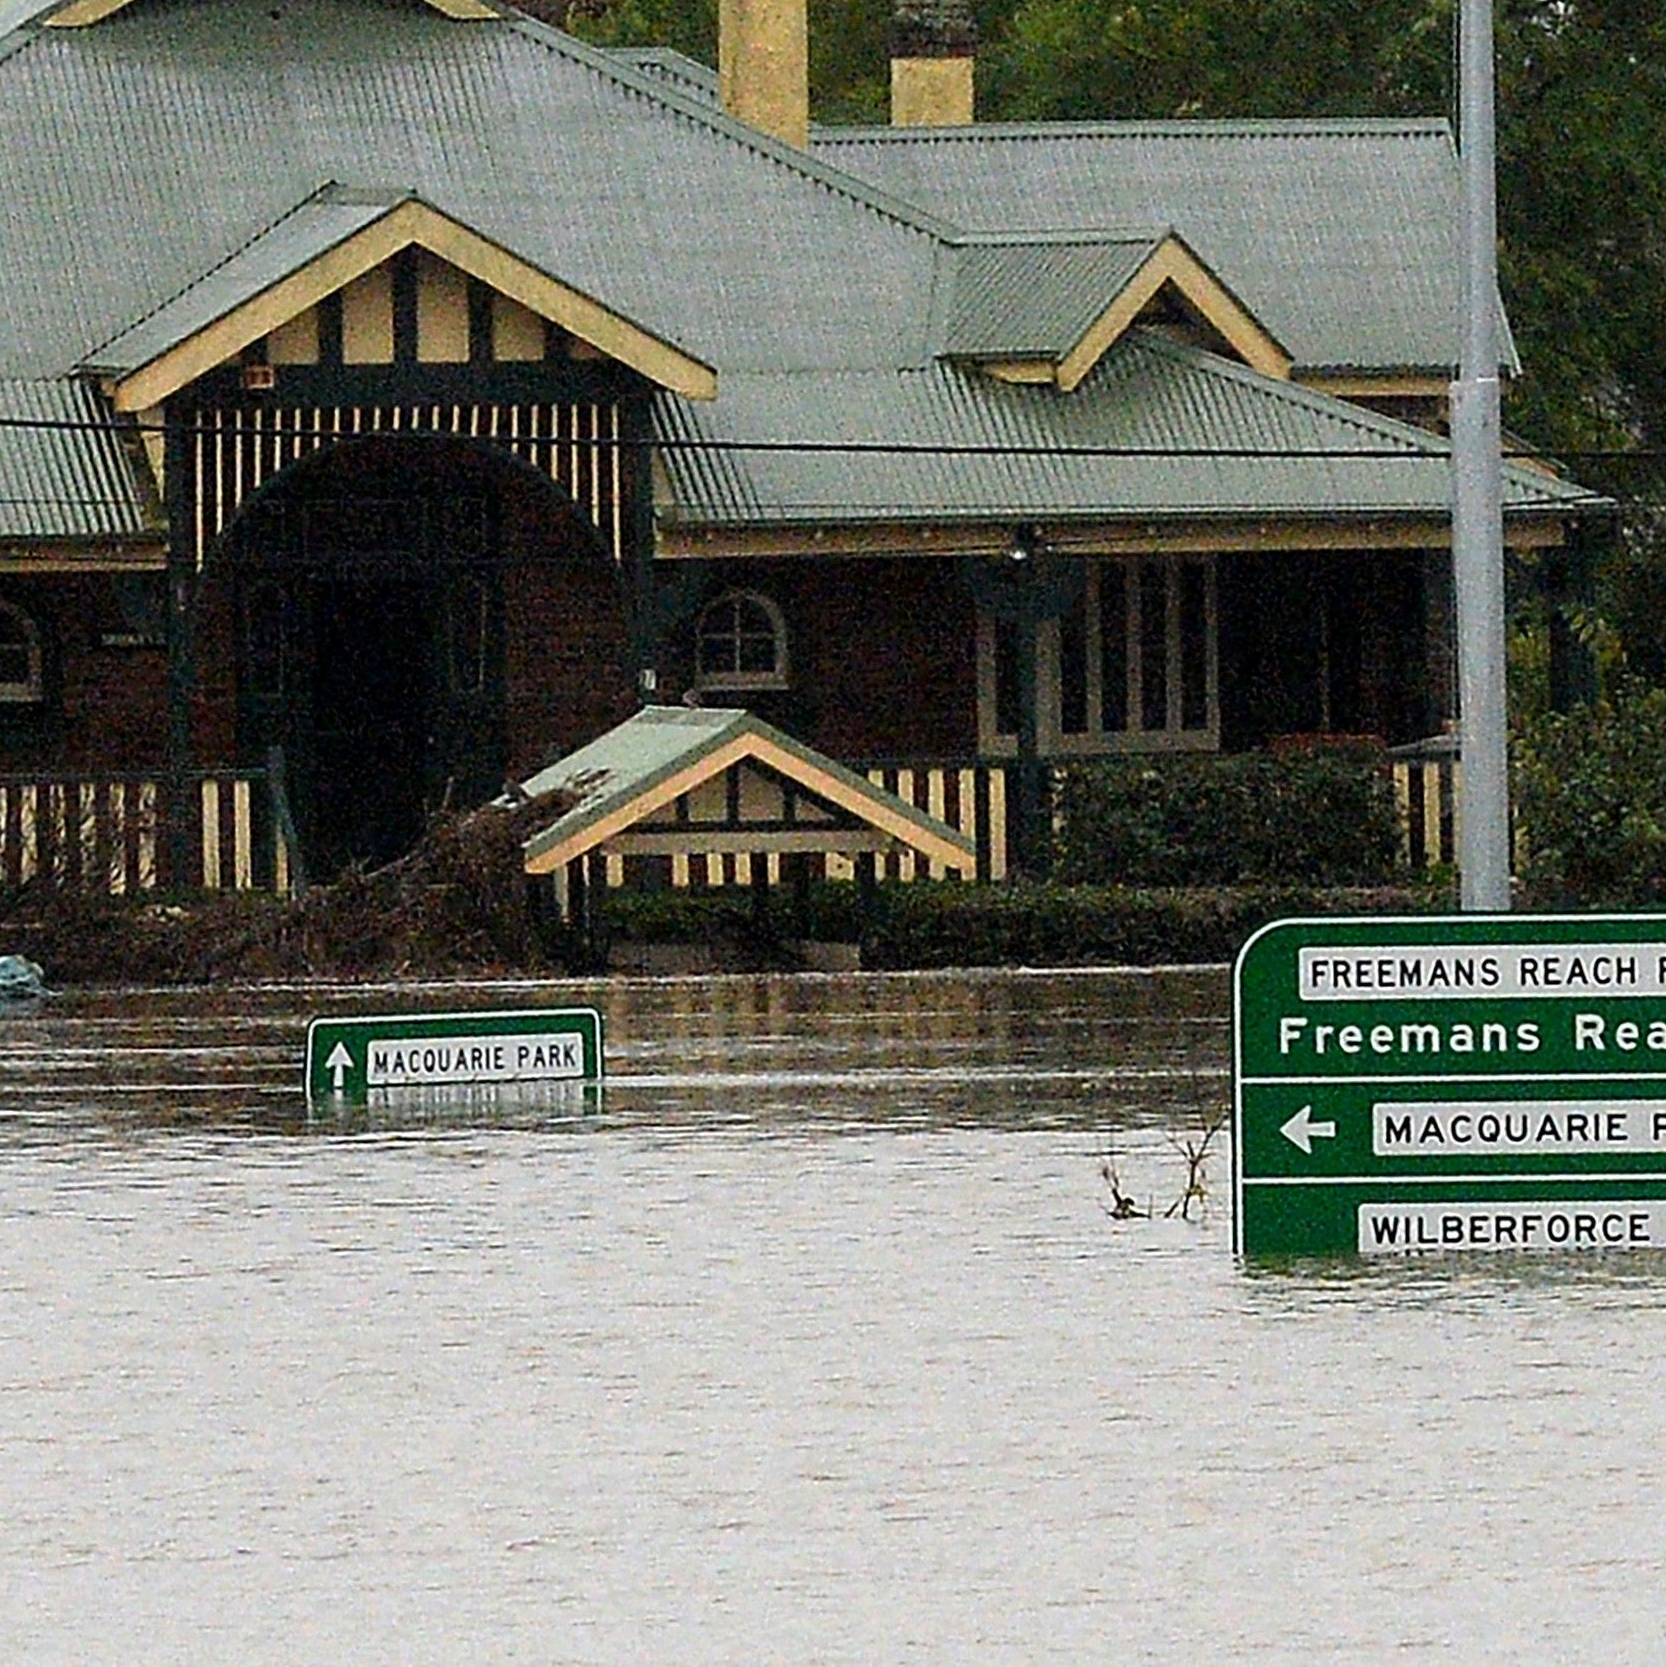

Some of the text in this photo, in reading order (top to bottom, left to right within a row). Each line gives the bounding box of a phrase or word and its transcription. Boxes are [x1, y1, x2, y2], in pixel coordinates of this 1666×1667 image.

[1311, 959, 1500, 988] FREEMANS
[1520, 958, 1636, 986] REACH
[1280, 1017, 1541, 1054] Freemans
[373, 1044, 576, 1074] MACQUARIE PARK
[1385, 1114, 1628, 1144] MACQUARIE
[1372, 1214, 1649, 1244] WILBERFORCE
